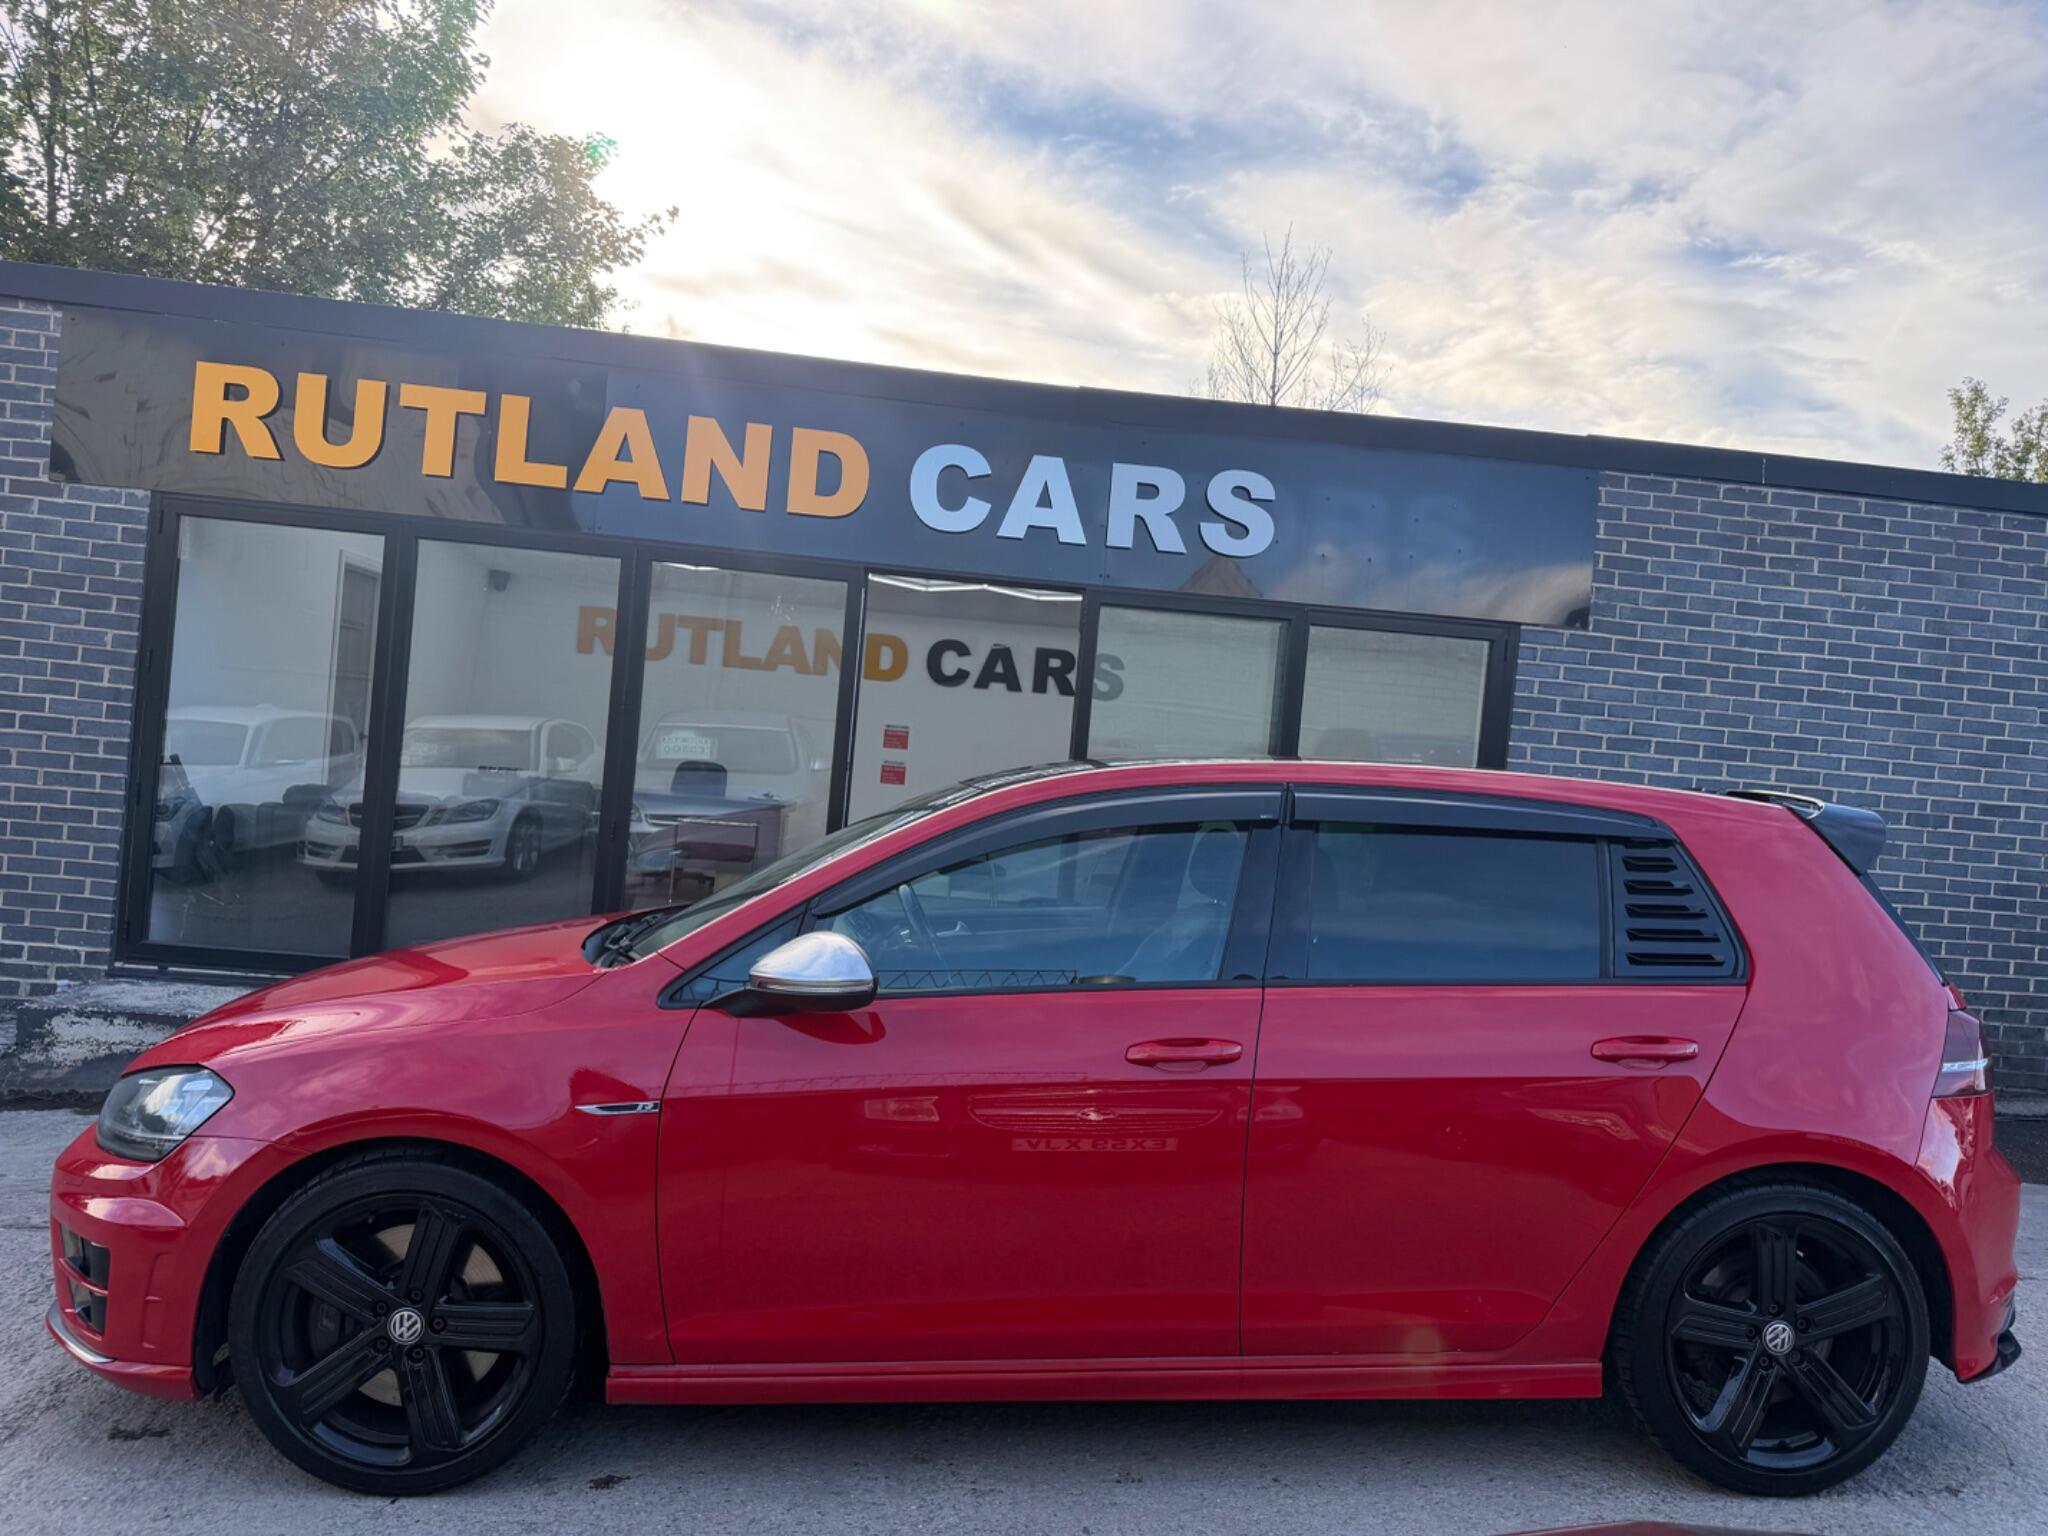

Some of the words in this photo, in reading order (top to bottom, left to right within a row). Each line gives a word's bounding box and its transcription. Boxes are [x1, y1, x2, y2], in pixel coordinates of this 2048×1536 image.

[188, 361, 870, 518] RUTLAND
[909, 443, 1277, 558] CARS
[926, 638, 1125, 702] CARS
